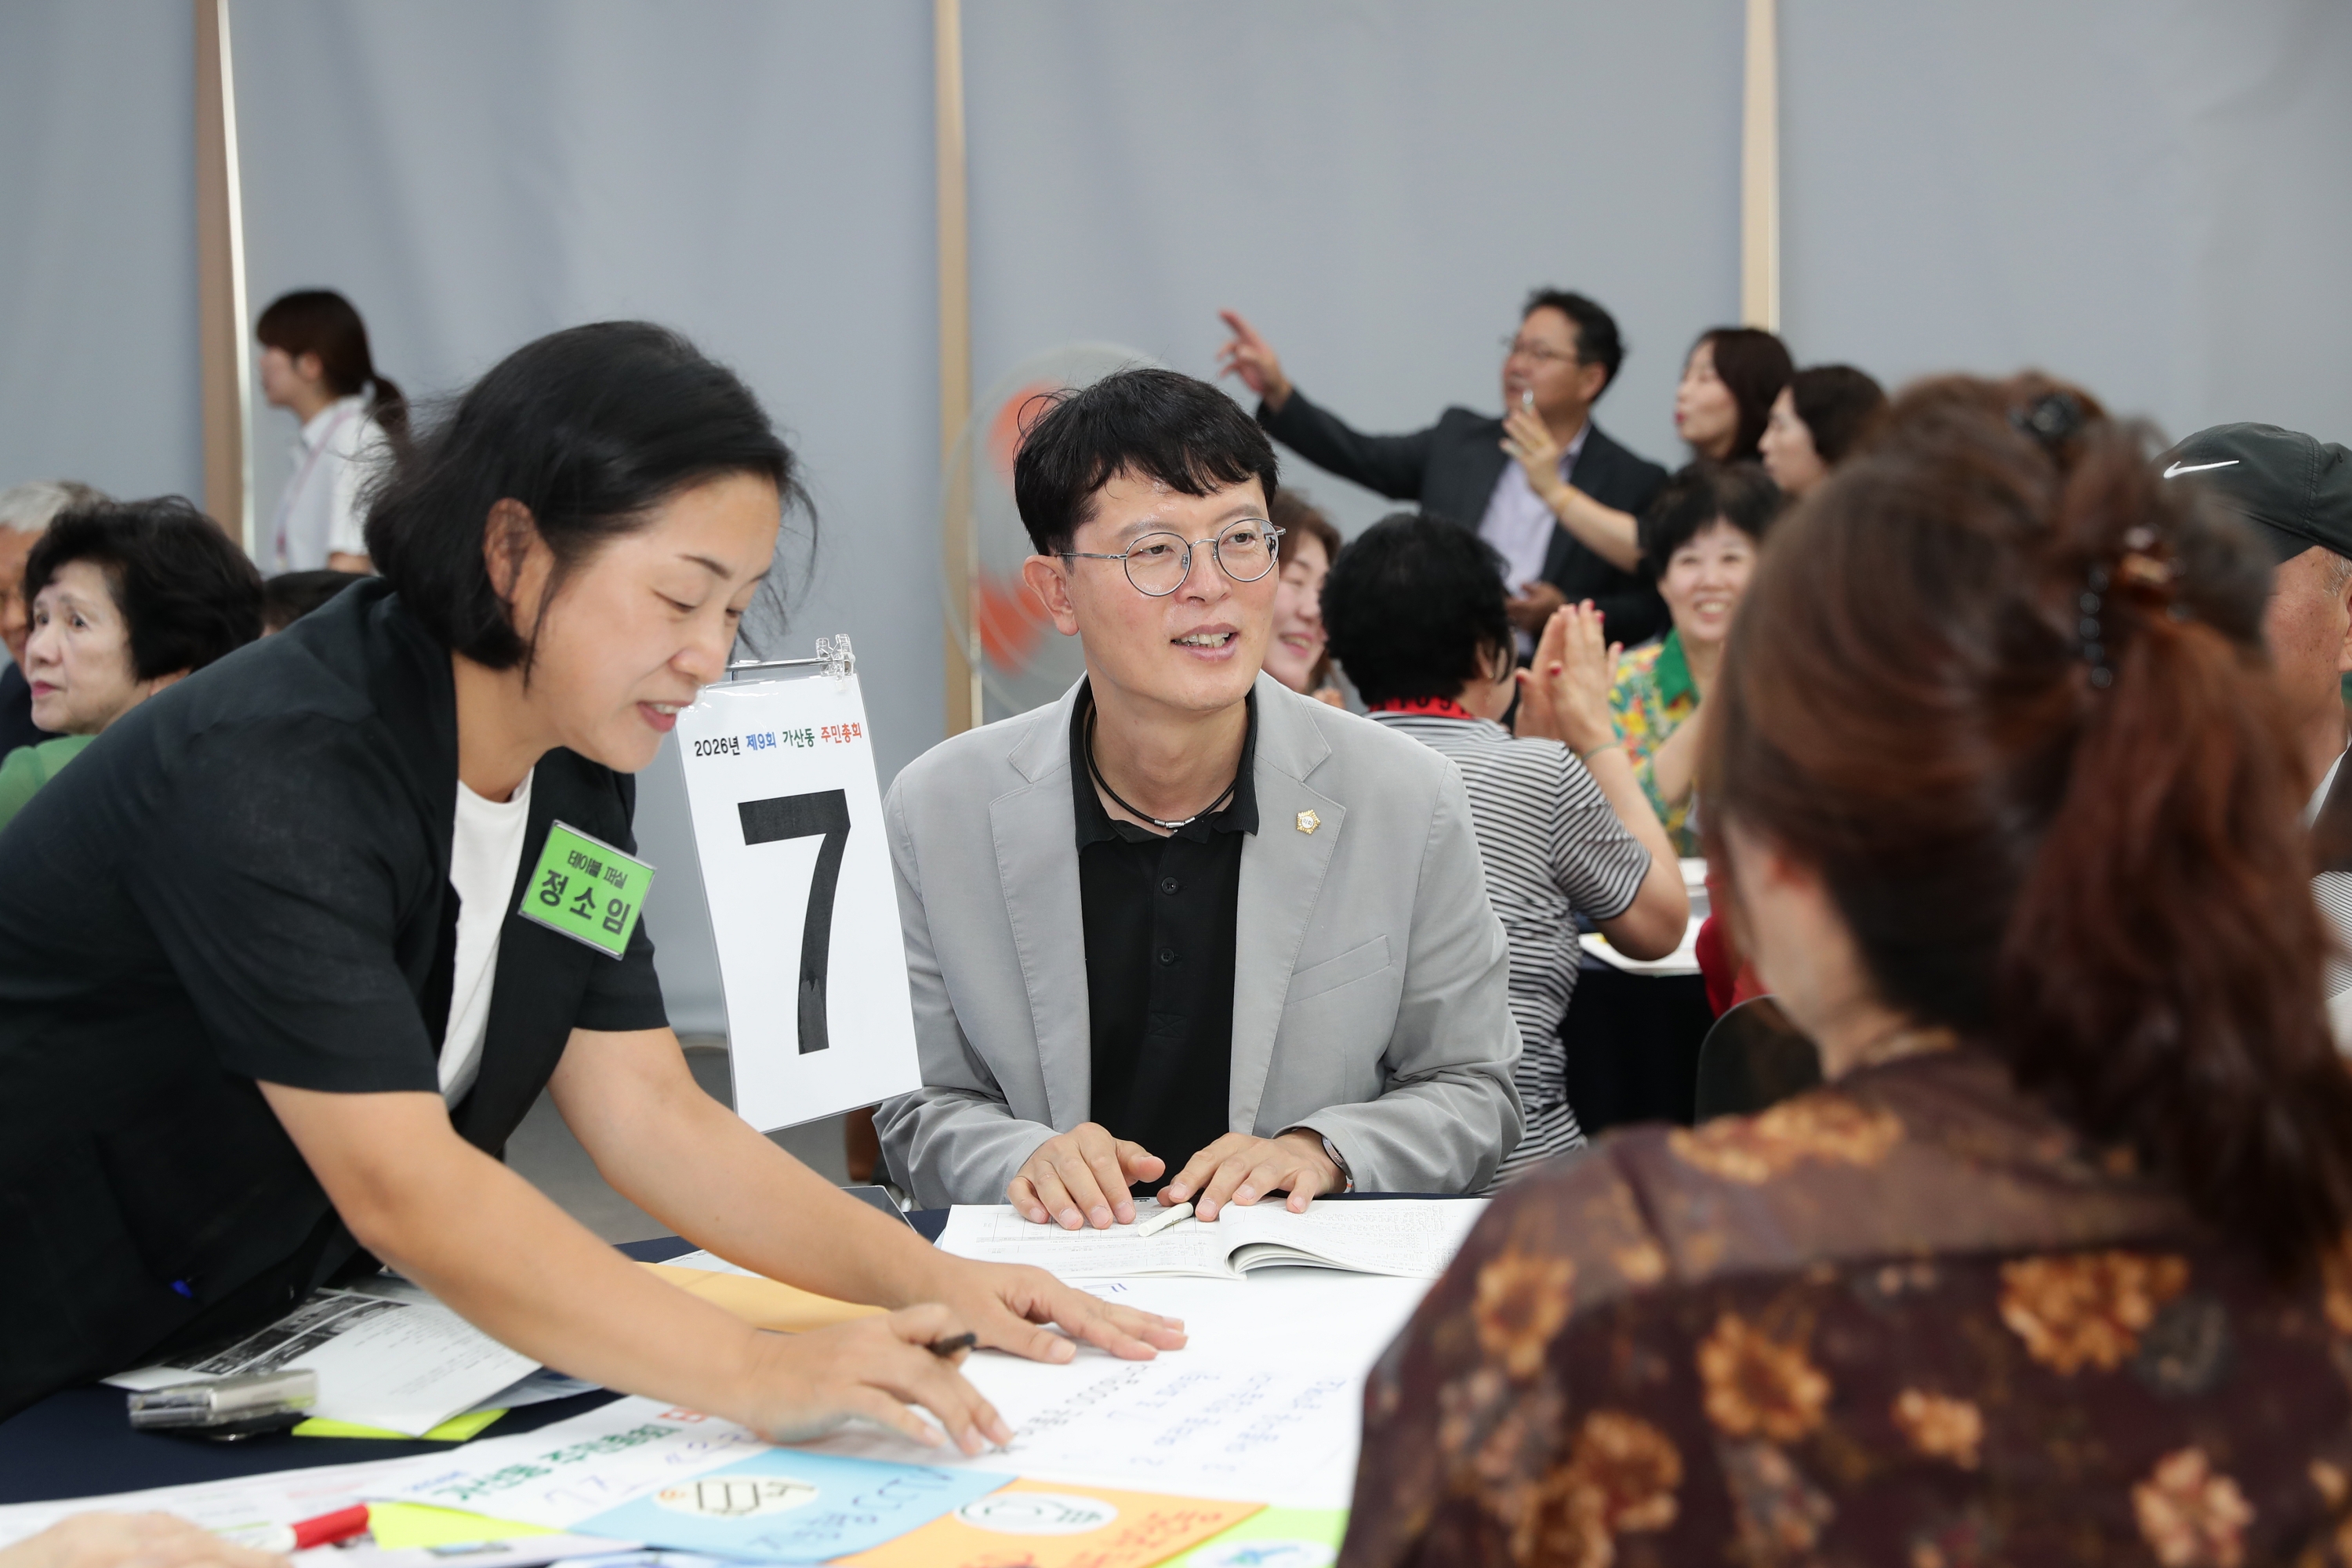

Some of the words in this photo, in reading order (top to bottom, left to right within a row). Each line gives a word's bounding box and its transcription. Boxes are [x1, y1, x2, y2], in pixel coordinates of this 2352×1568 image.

[694, 735, 741, 757] 2026년
[746, 731, 777, 751] 제9회
[782, 727, 815, 749] 가산동
[820, 722, 862, 744] 주민총회
[567, 850, 602, 878] 테이블
[603, 866, 629, 890] 퍼실
[539, 869, 631, 935] 정소임
[738, 788, 851, 1055] 7
